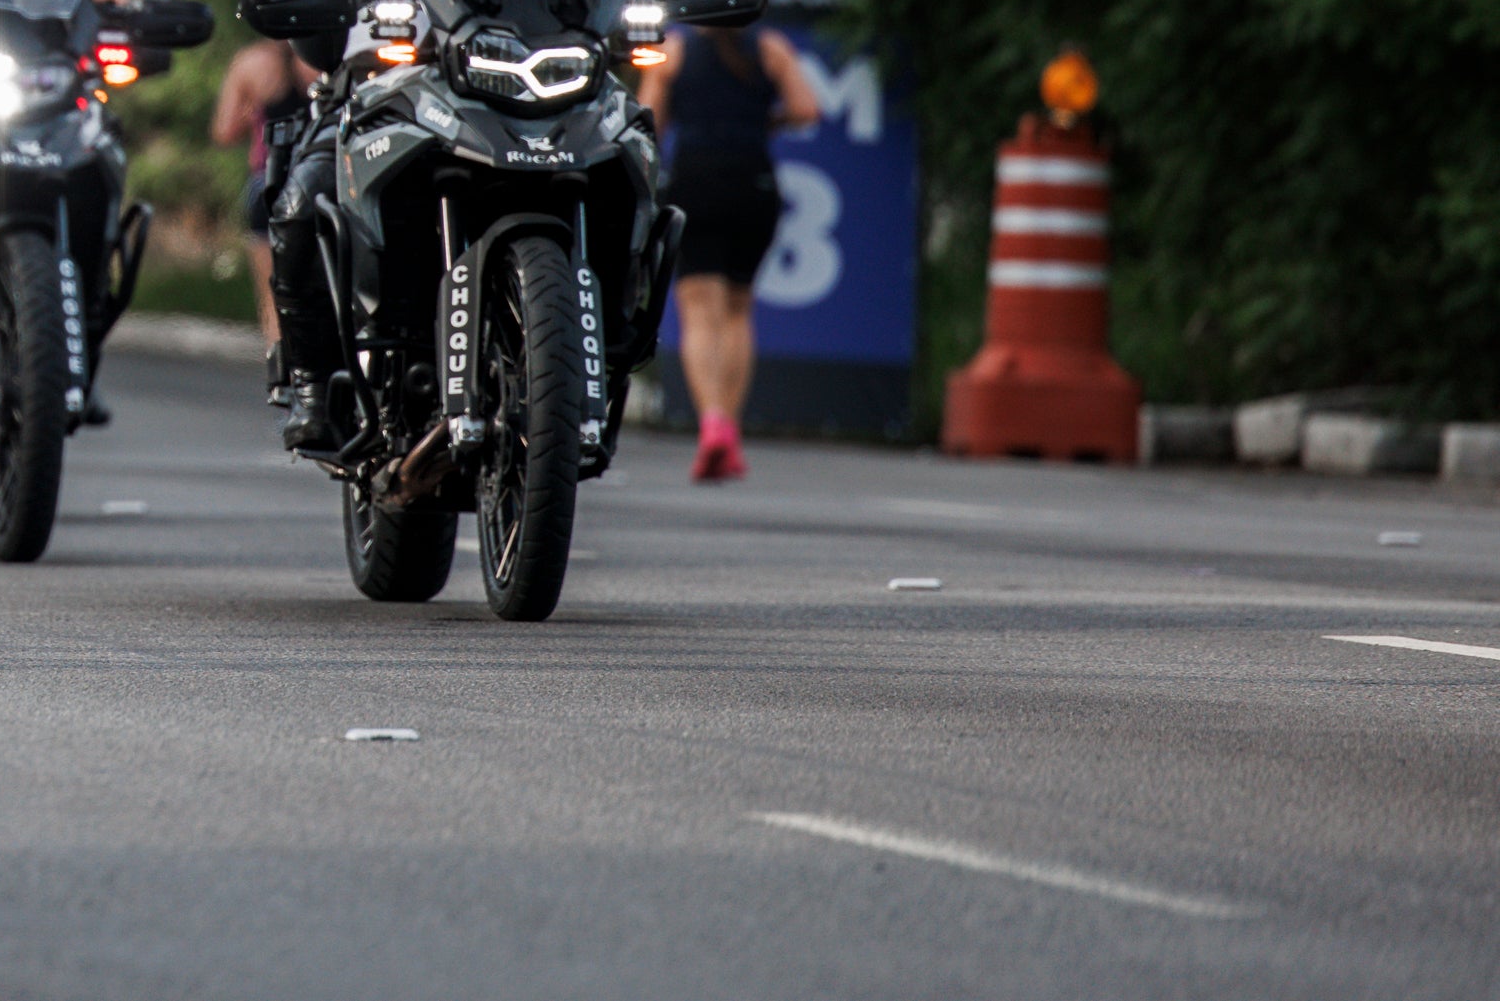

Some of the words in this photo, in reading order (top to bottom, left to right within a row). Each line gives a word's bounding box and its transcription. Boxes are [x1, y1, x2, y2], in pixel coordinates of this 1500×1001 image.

[506, 150, 574, 165] ROCAM
[448, 265, 468, 395] CHOQUE
[577, 268, 601, 399] CHOQUE
